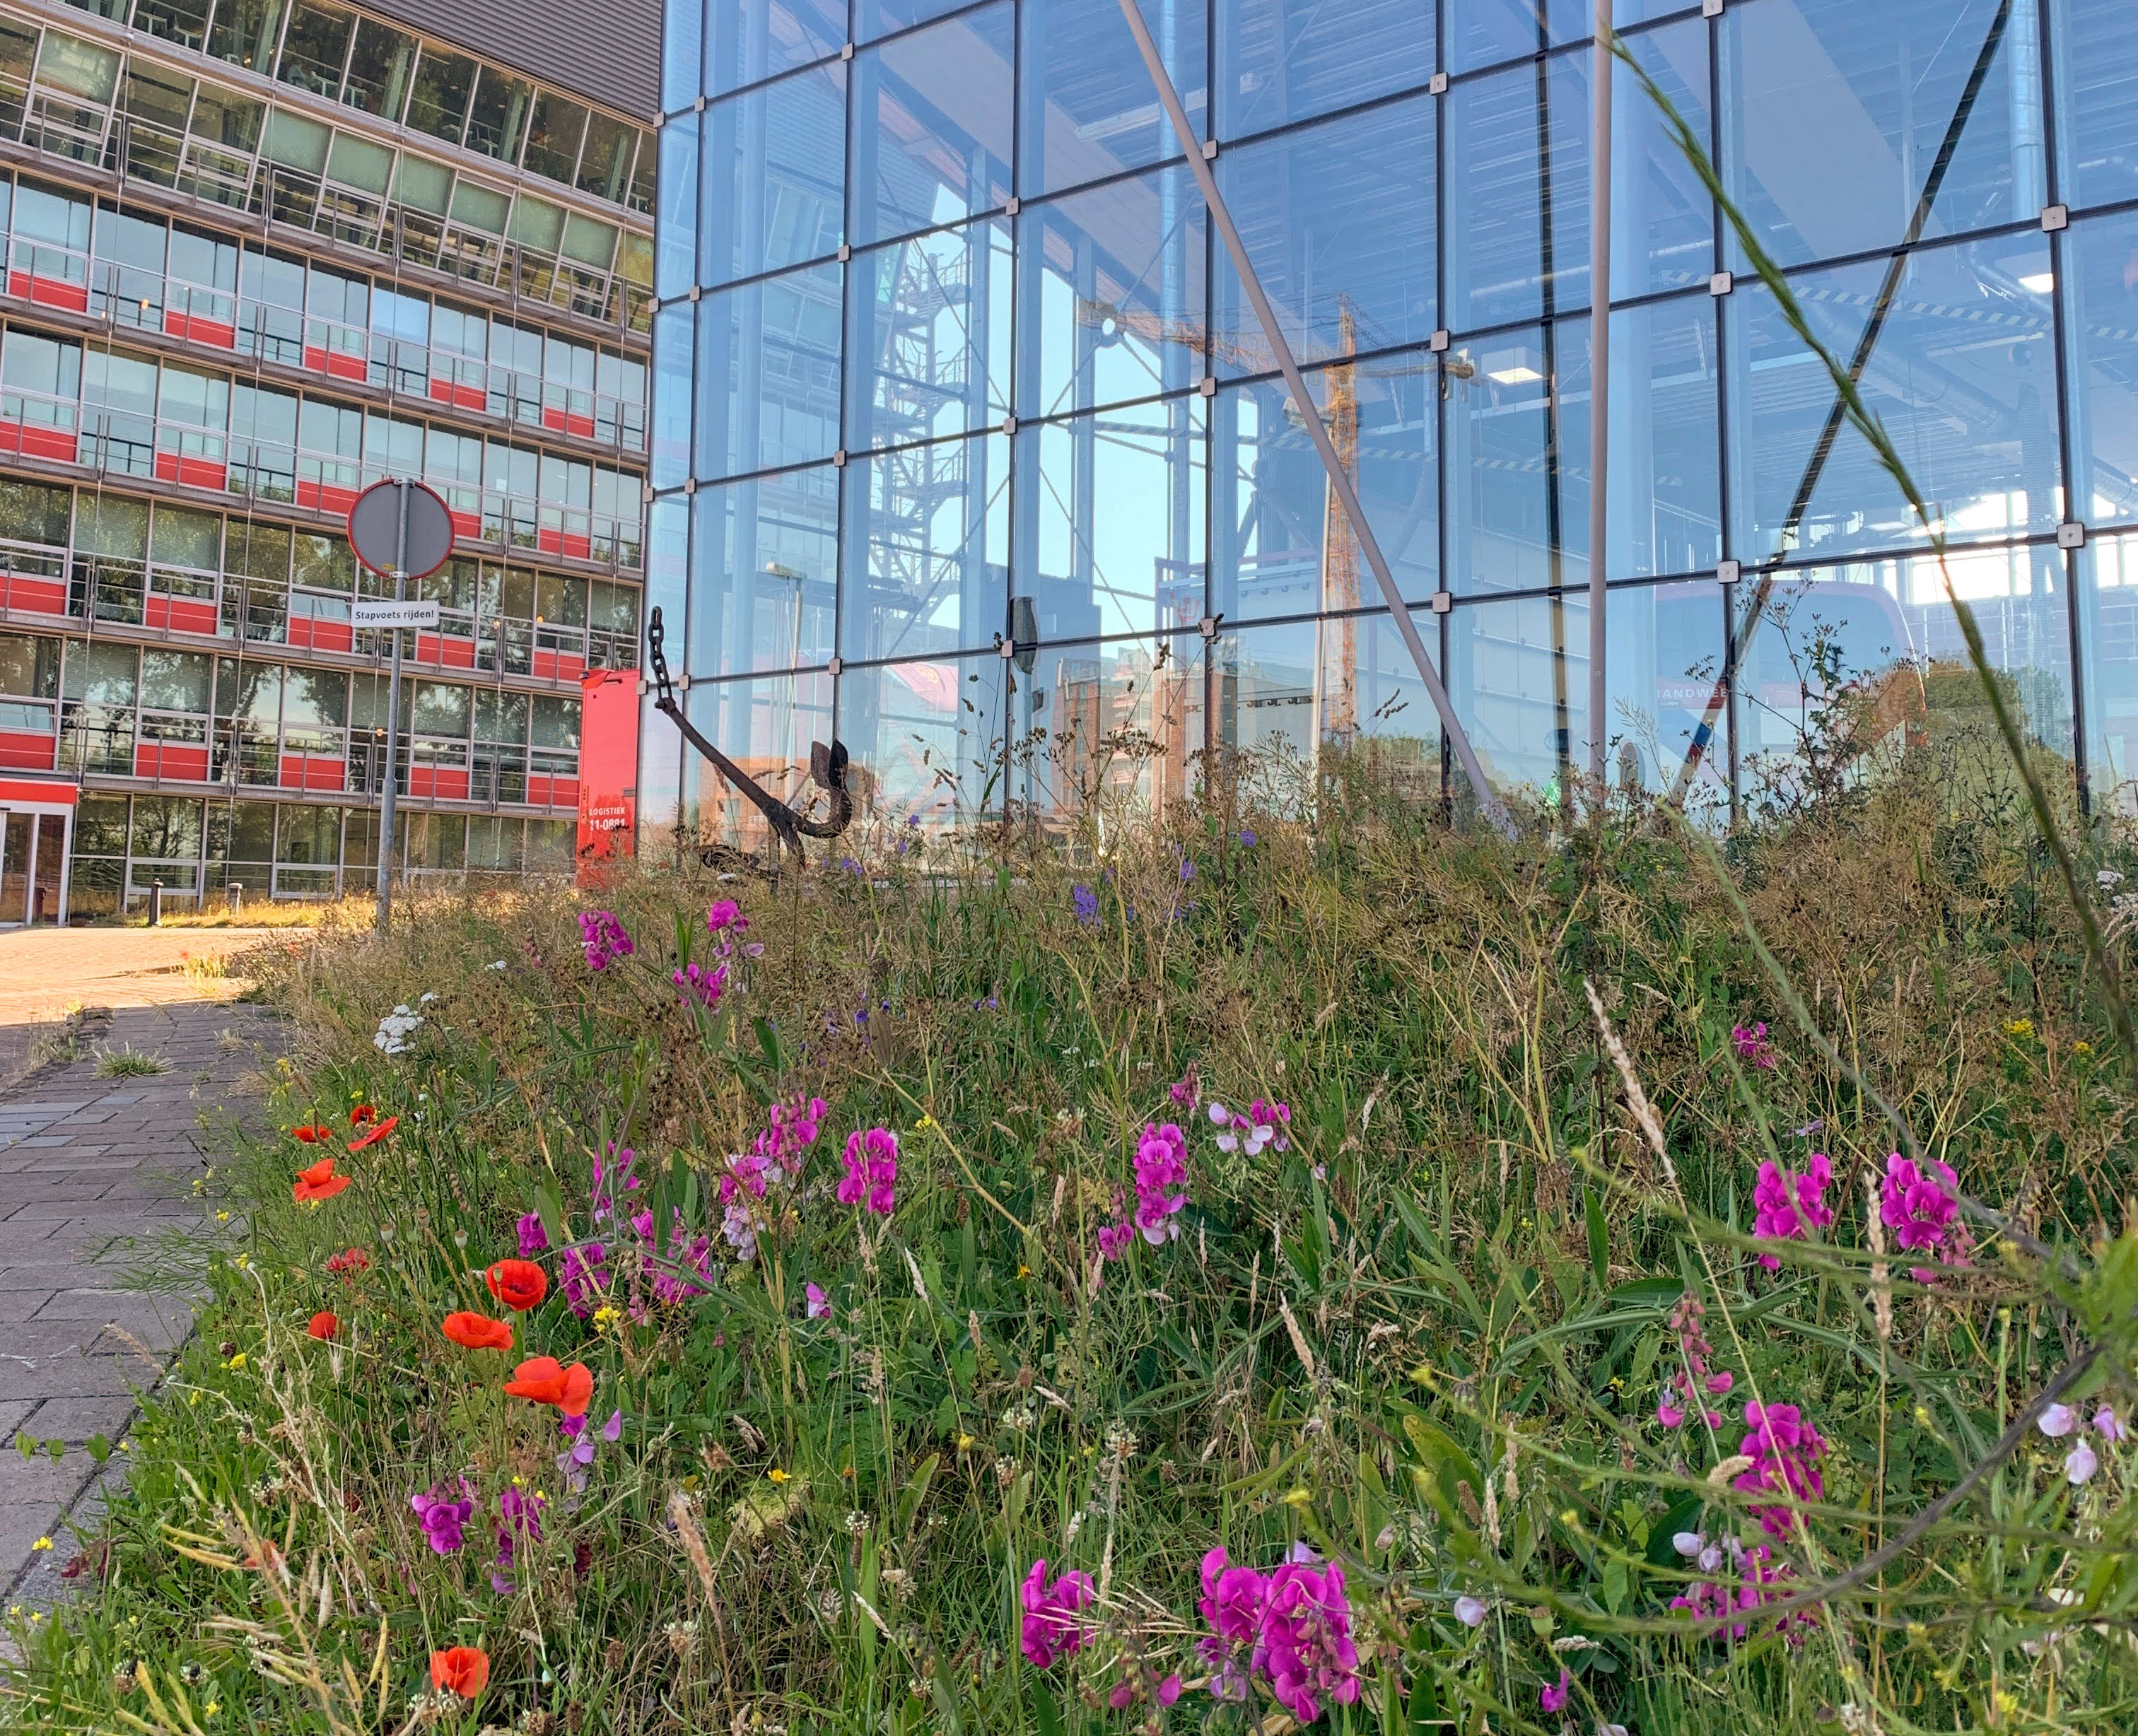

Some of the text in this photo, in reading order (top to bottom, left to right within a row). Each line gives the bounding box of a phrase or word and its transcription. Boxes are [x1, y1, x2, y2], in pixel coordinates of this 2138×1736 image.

[356, 610, 433, 621] Stapvoets rijden!
[589, 807, 625, 816] LOGISTIEK
